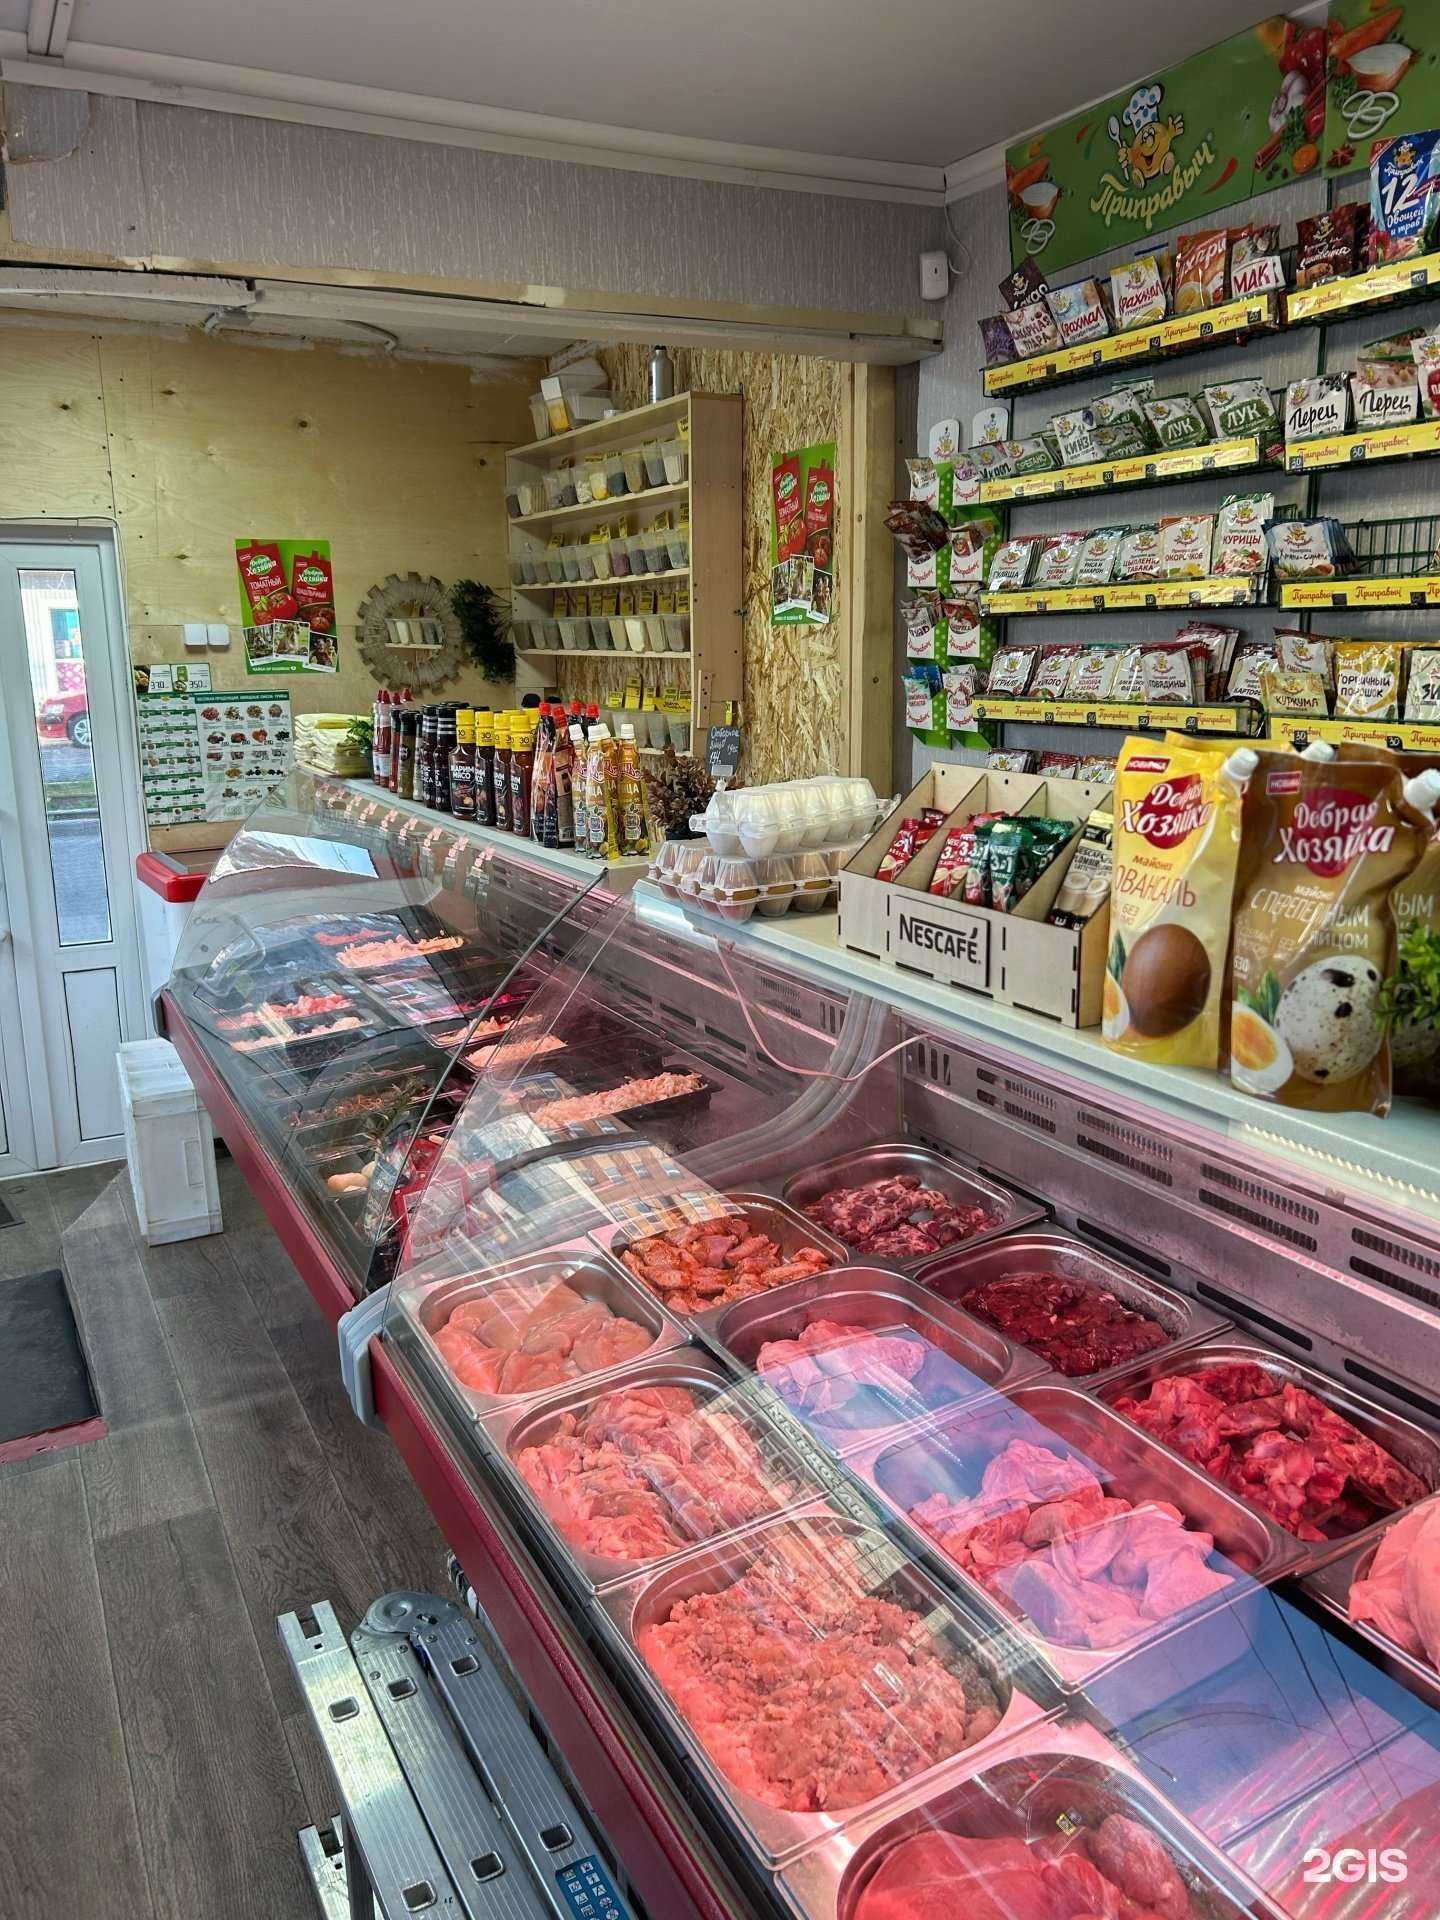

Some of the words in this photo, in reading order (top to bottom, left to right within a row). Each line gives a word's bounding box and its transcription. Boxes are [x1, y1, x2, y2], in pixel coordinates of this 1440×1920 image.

[1381, 173, 1419, 215] 12
[1387, 206, 1425, 228] Овощей
[1397, 220, 1421, 237] трав
[1233, 263, 1270, 294] МАК
[1360, 390, 1412, 418] Перец
[1227, 403, 1262, 429] ЛУК
[1288, 404, 1338, 433] Перец
[1167, 418, 1195, 441] ЛУК
[1353, 449, 1364, 461] 30
[1363, 437, 1410, 454] Приправыч
[1222, 534, 1262, 547] КУРИЦЫ
[1355, 584, 1402, 604] Приправыч
[189, 679, 203, 689] 350
[1276, 695, 1319, 707] КУРКУМА
[519, 736, 531, 745] 30
[1295, 801, 1378, 834] Добрая
[1273, 824, 1396, 865] Хозяйка
[1233, 957, 1250, 974] 630
